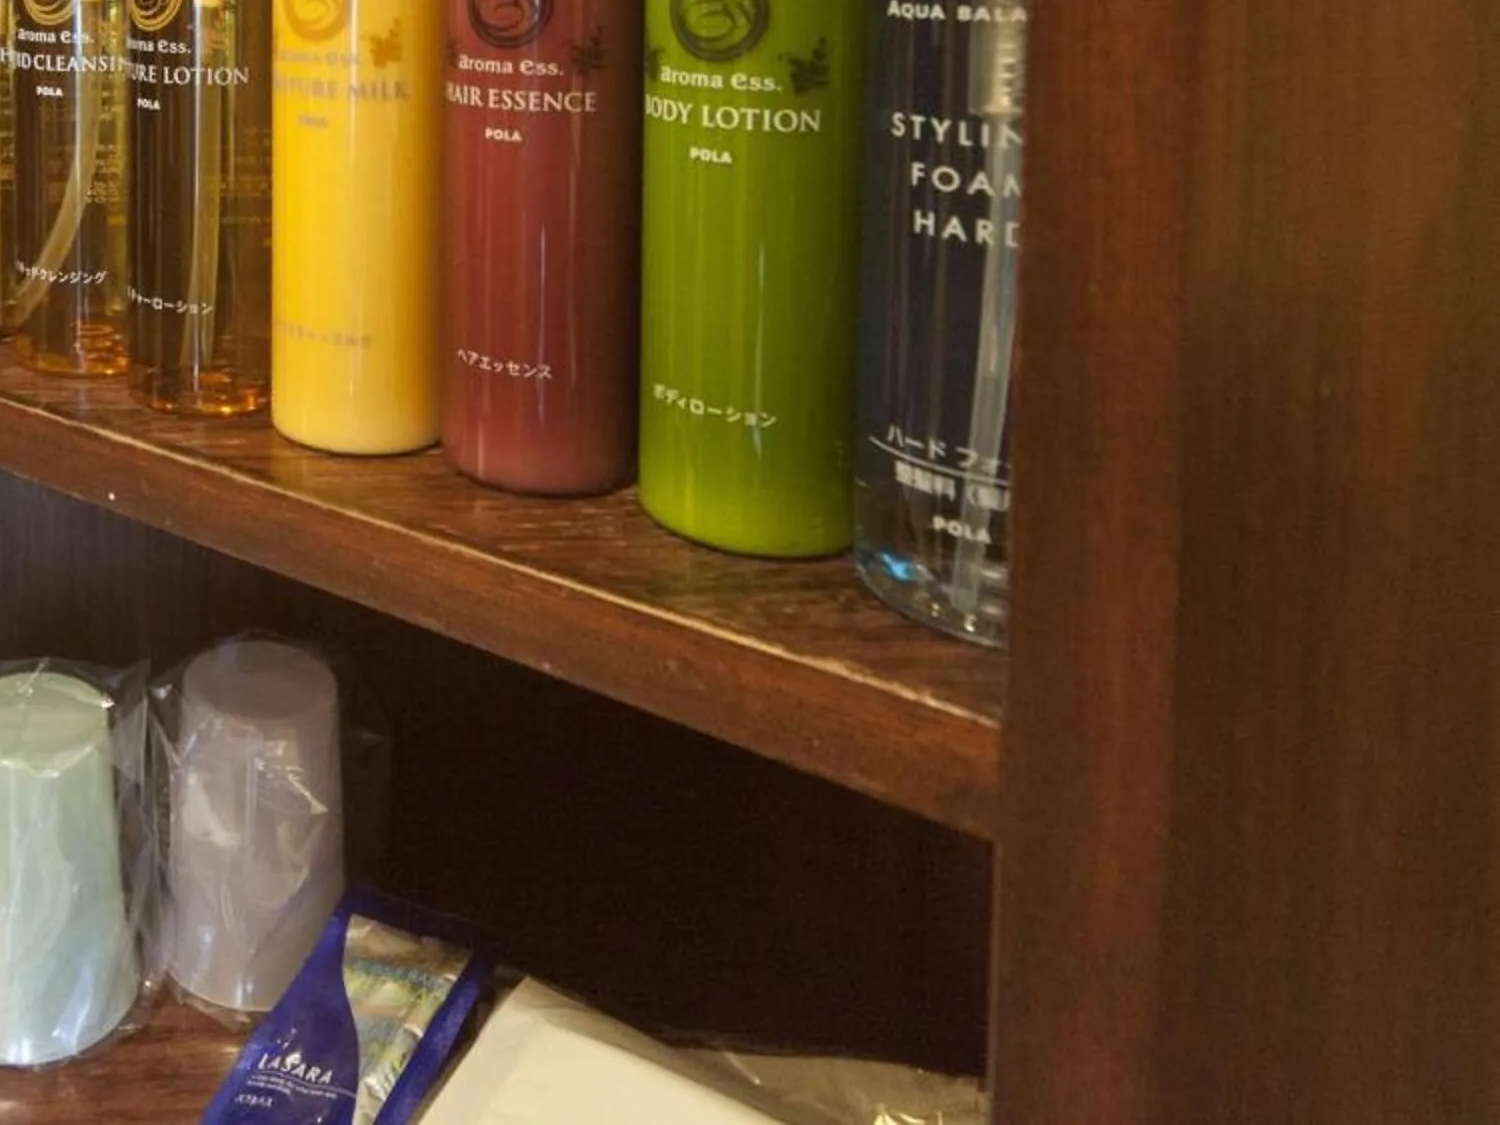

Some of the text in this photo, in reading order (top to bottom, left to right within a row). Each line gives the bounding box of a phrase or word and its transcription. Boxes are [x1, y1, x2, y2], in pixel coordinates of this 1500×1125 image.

[886, 0, 946, 21] AQUA
[163, 65, 250, 85] LOTION
[458, 53, 565, 77] aroma ess.
[659, 65, 783, 93] aroma ess.
[487, 88, 598, 113] ESSENCE
[701, 106, 822, 133] LOTION
[485, 126, 523, 143] POLA
[689, 146, 733, 165] POLA
[932, 514, 993, 545] POLA
